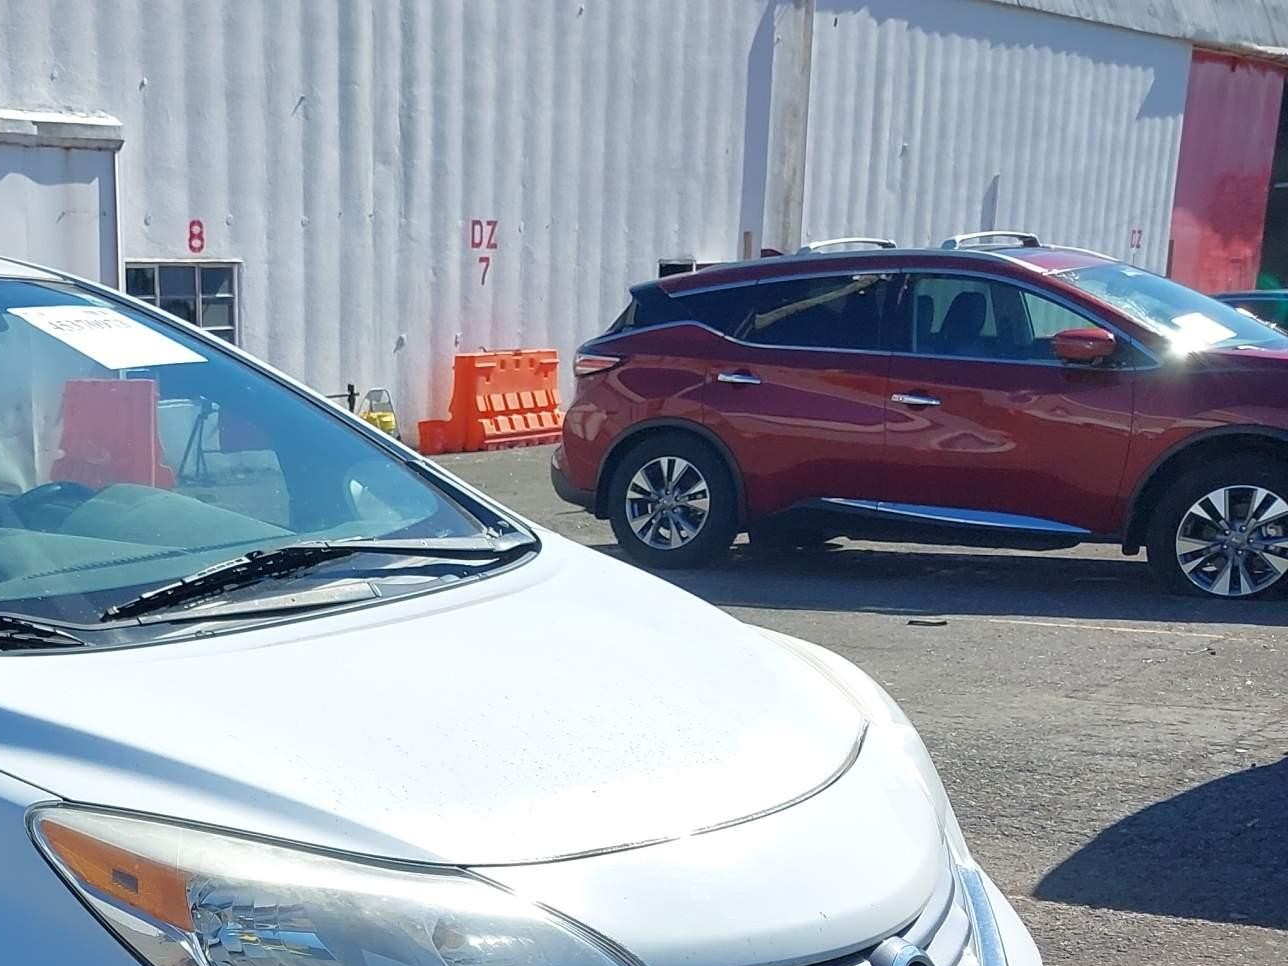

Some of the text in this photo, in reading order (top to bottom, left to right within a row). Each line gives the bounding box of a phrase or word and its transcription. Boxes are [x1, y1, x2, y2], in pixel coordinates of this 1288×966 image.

[188, 219, 205, 254] 8
[471, 219, 498, 249] DZ
[478, 256, 490, 286] 7
